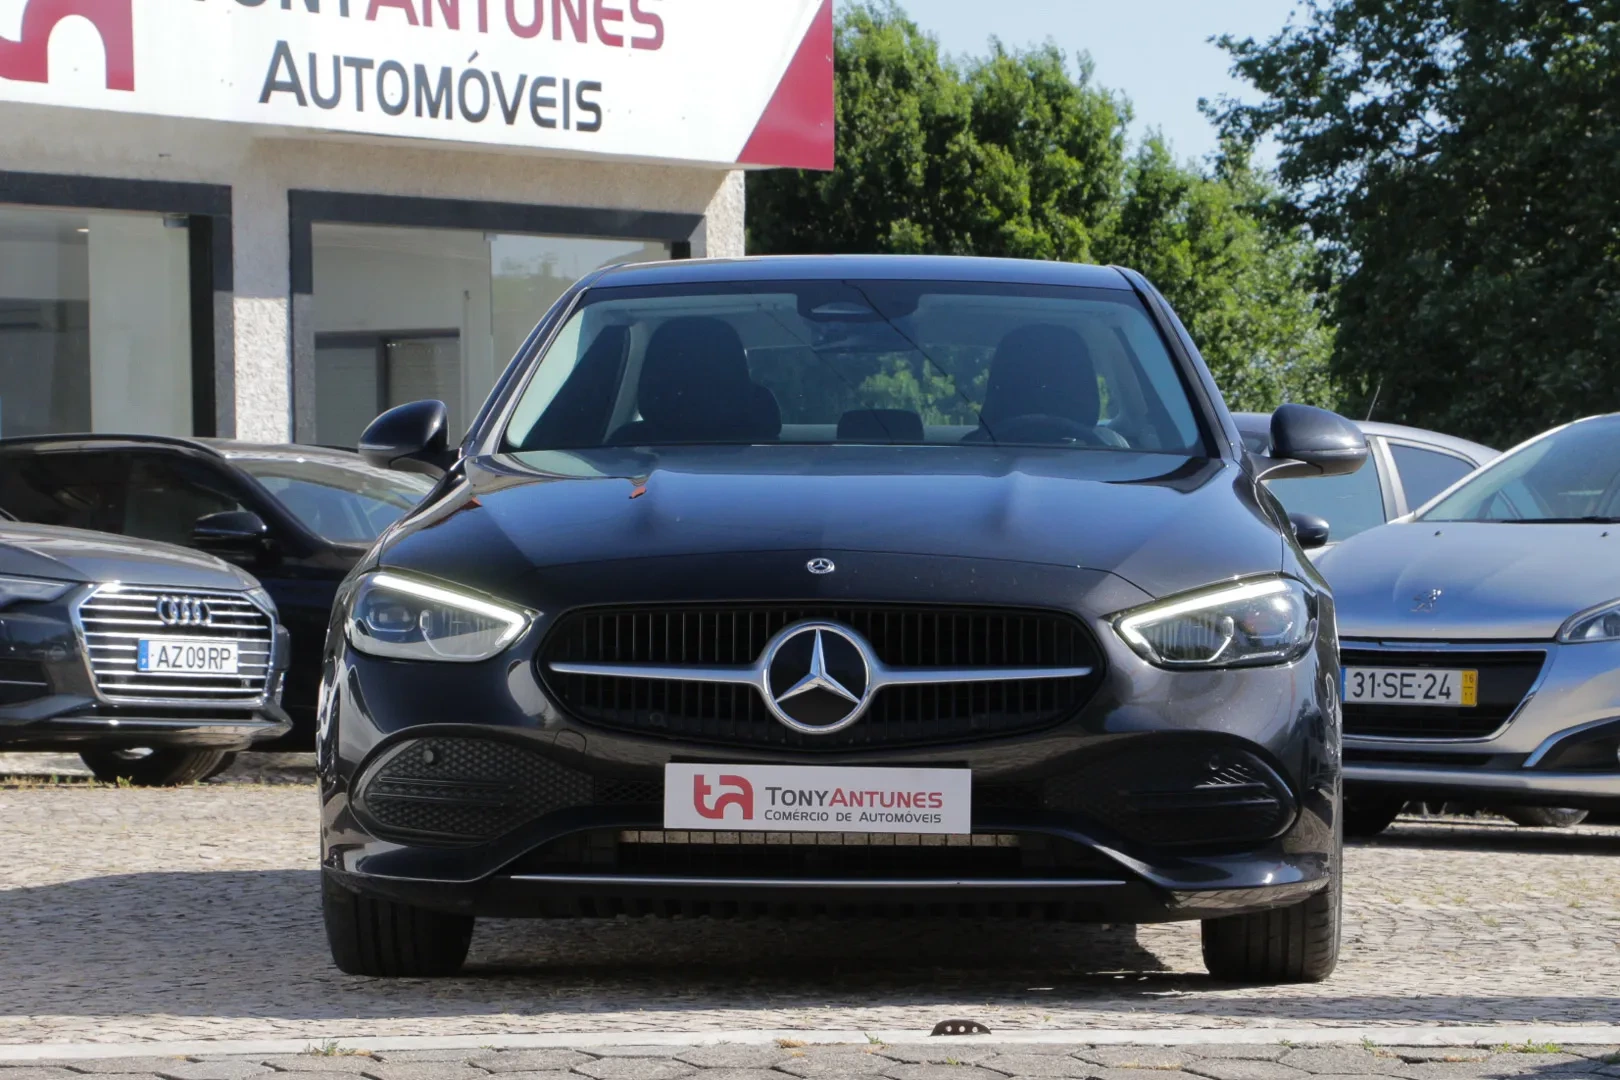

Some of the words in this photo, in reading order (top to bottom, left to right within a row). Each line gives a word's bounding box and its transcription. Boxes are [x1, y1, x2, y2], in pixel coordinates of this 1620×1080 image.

[258, 39, 602, 133] AUTOMÓVEIS
[764, 808, 829, 822] COMÉRCIO
[836, 812, 852, 822] DE
[859, 810, 942, 824] AUTOMÓVEIS
